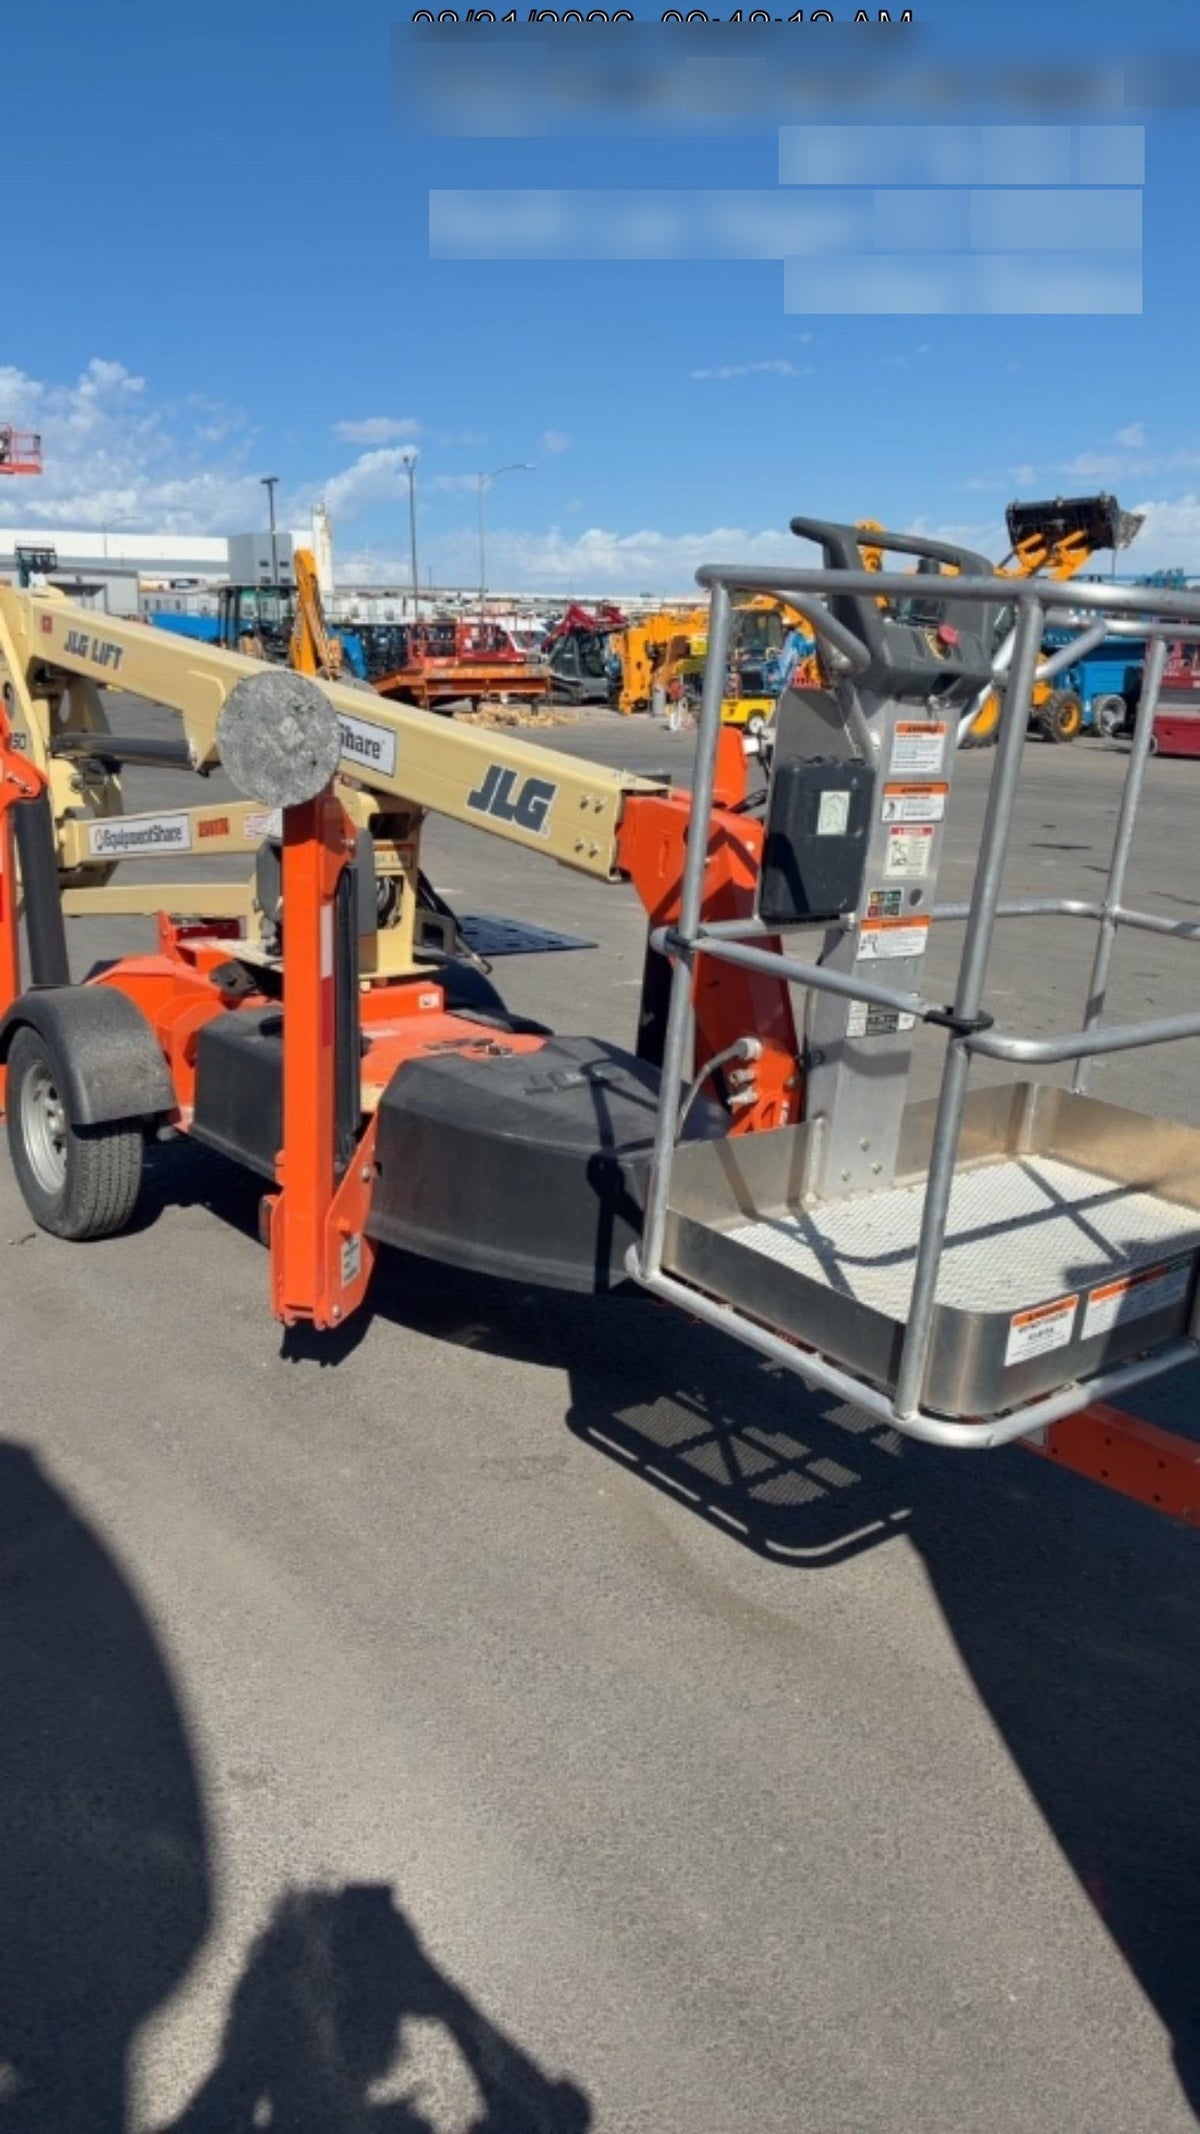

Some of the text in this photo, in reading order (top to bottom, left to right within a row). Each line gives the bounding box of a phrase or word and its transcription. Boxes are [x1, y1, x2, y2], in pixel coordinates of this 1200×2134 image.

[91, 638, 124, 670] LIFT
[340, 723, 380, 759] hare
[467, 764, 557, 834] JLG
[103, 824, 183, 849] EquipmentShare
